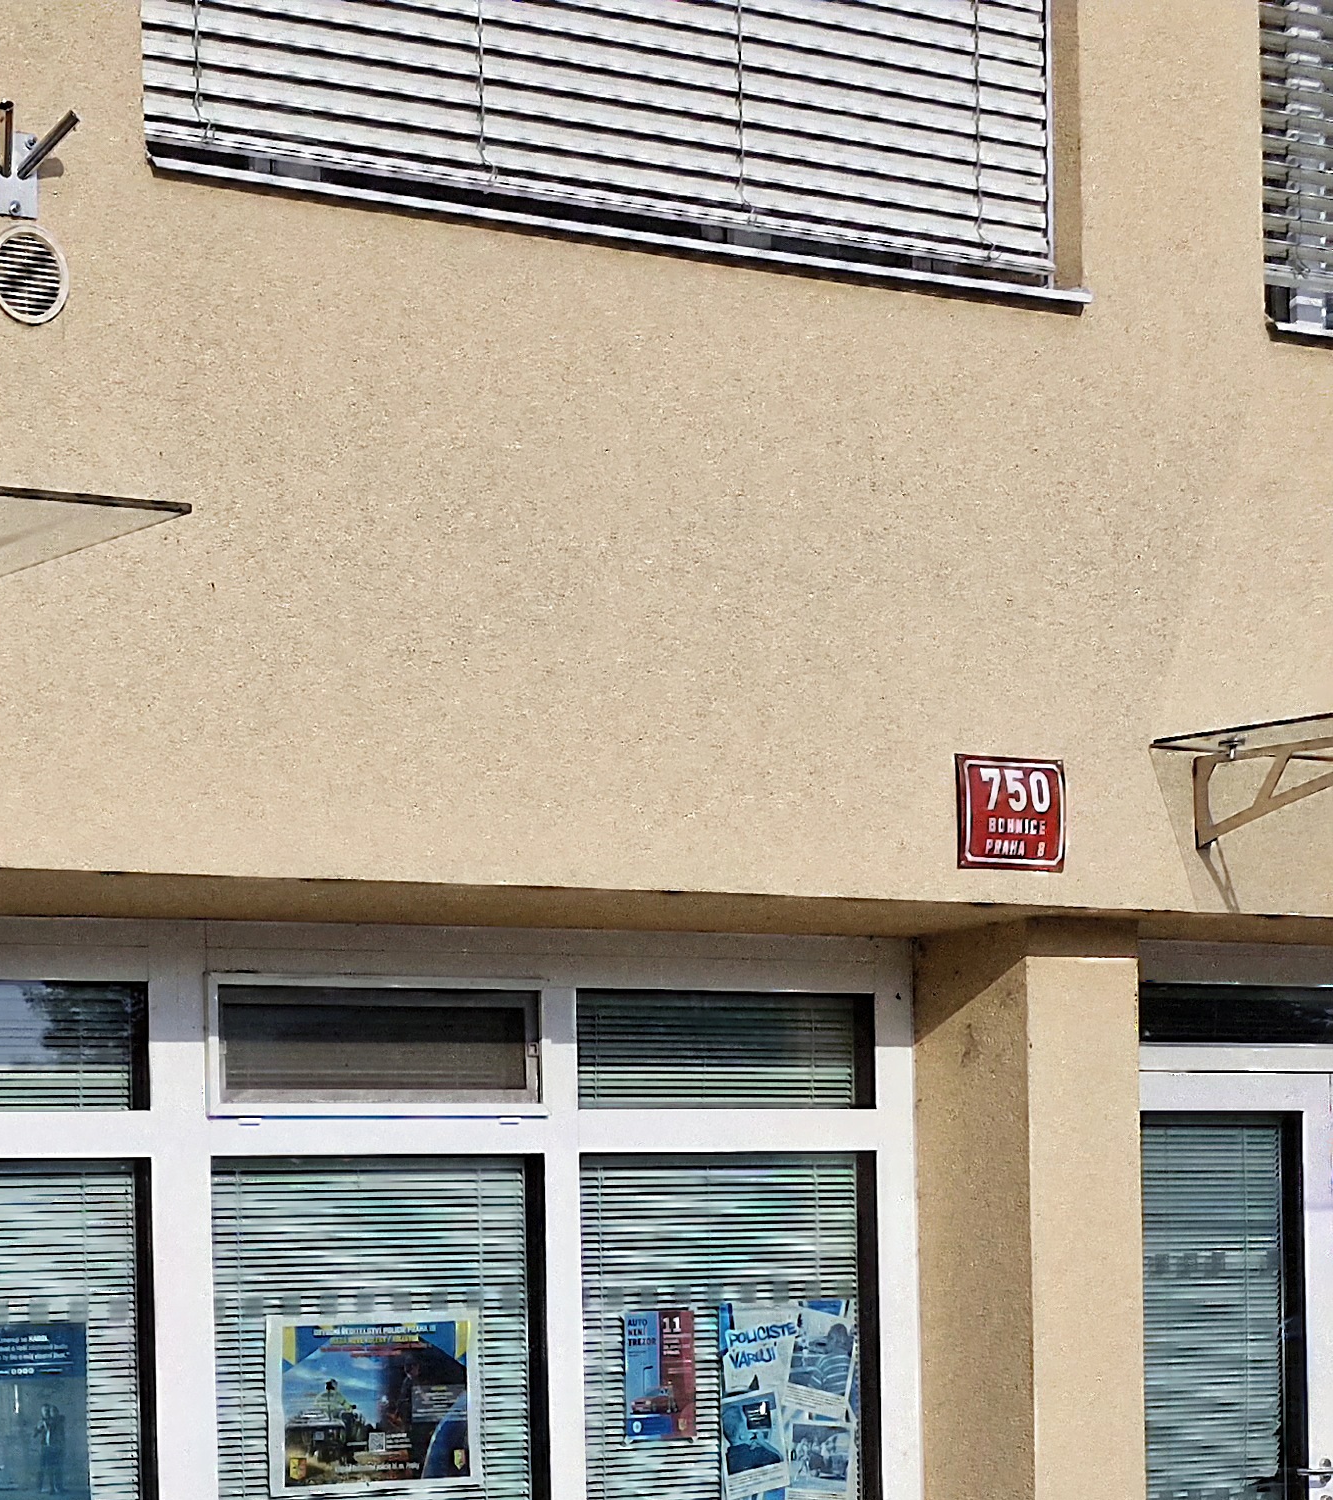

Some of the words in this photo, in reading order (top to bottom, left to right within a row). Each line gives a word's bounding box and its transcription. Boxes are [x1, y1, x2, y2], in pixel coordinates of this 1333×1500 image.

[980, 768, 1051, 812] 750
[988, 817, 1046, 835] BOHNICE
[985, 839, 1025, 856] PRAHA
[1037, 842, 1046, 857] 8
[628, 1319, 648, 1327] AUTO
[663, 1316, 682, 1333] 11
